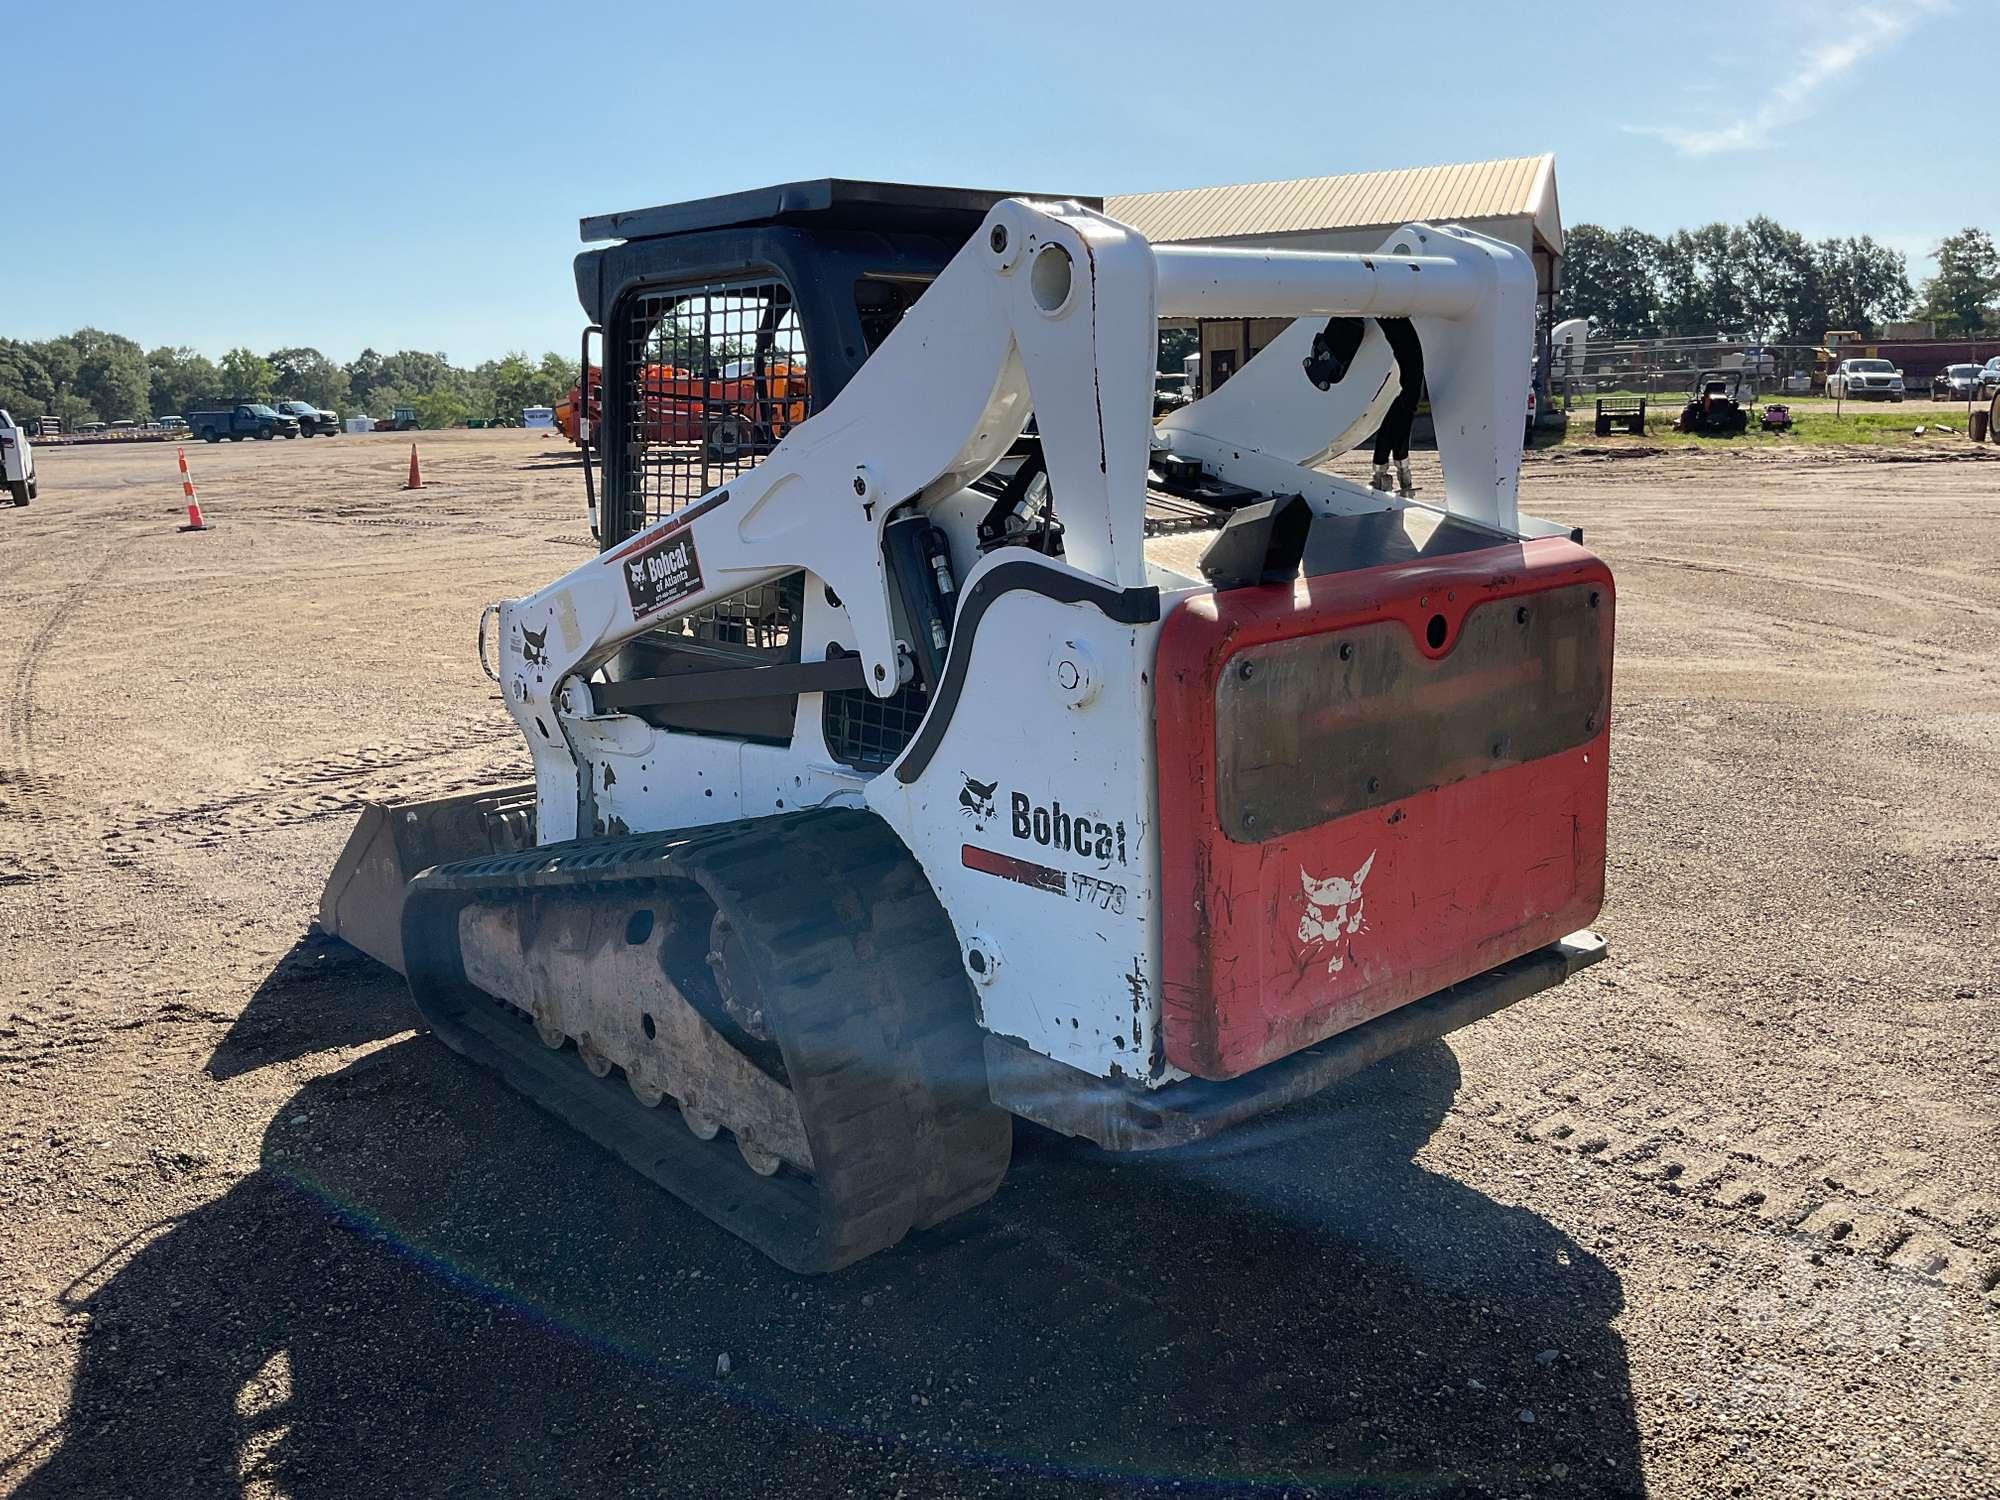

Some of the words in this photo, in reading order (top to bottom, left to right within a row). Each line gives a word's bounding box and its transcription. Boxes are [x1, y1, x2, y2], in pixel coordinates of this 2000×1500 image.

[647, 542, 689, 583] Bobcat
[656, 579, 663, 592] of
[664, 570, 688, 588] Atlanta
[1011, 791, 1127, 866] Bobcat
